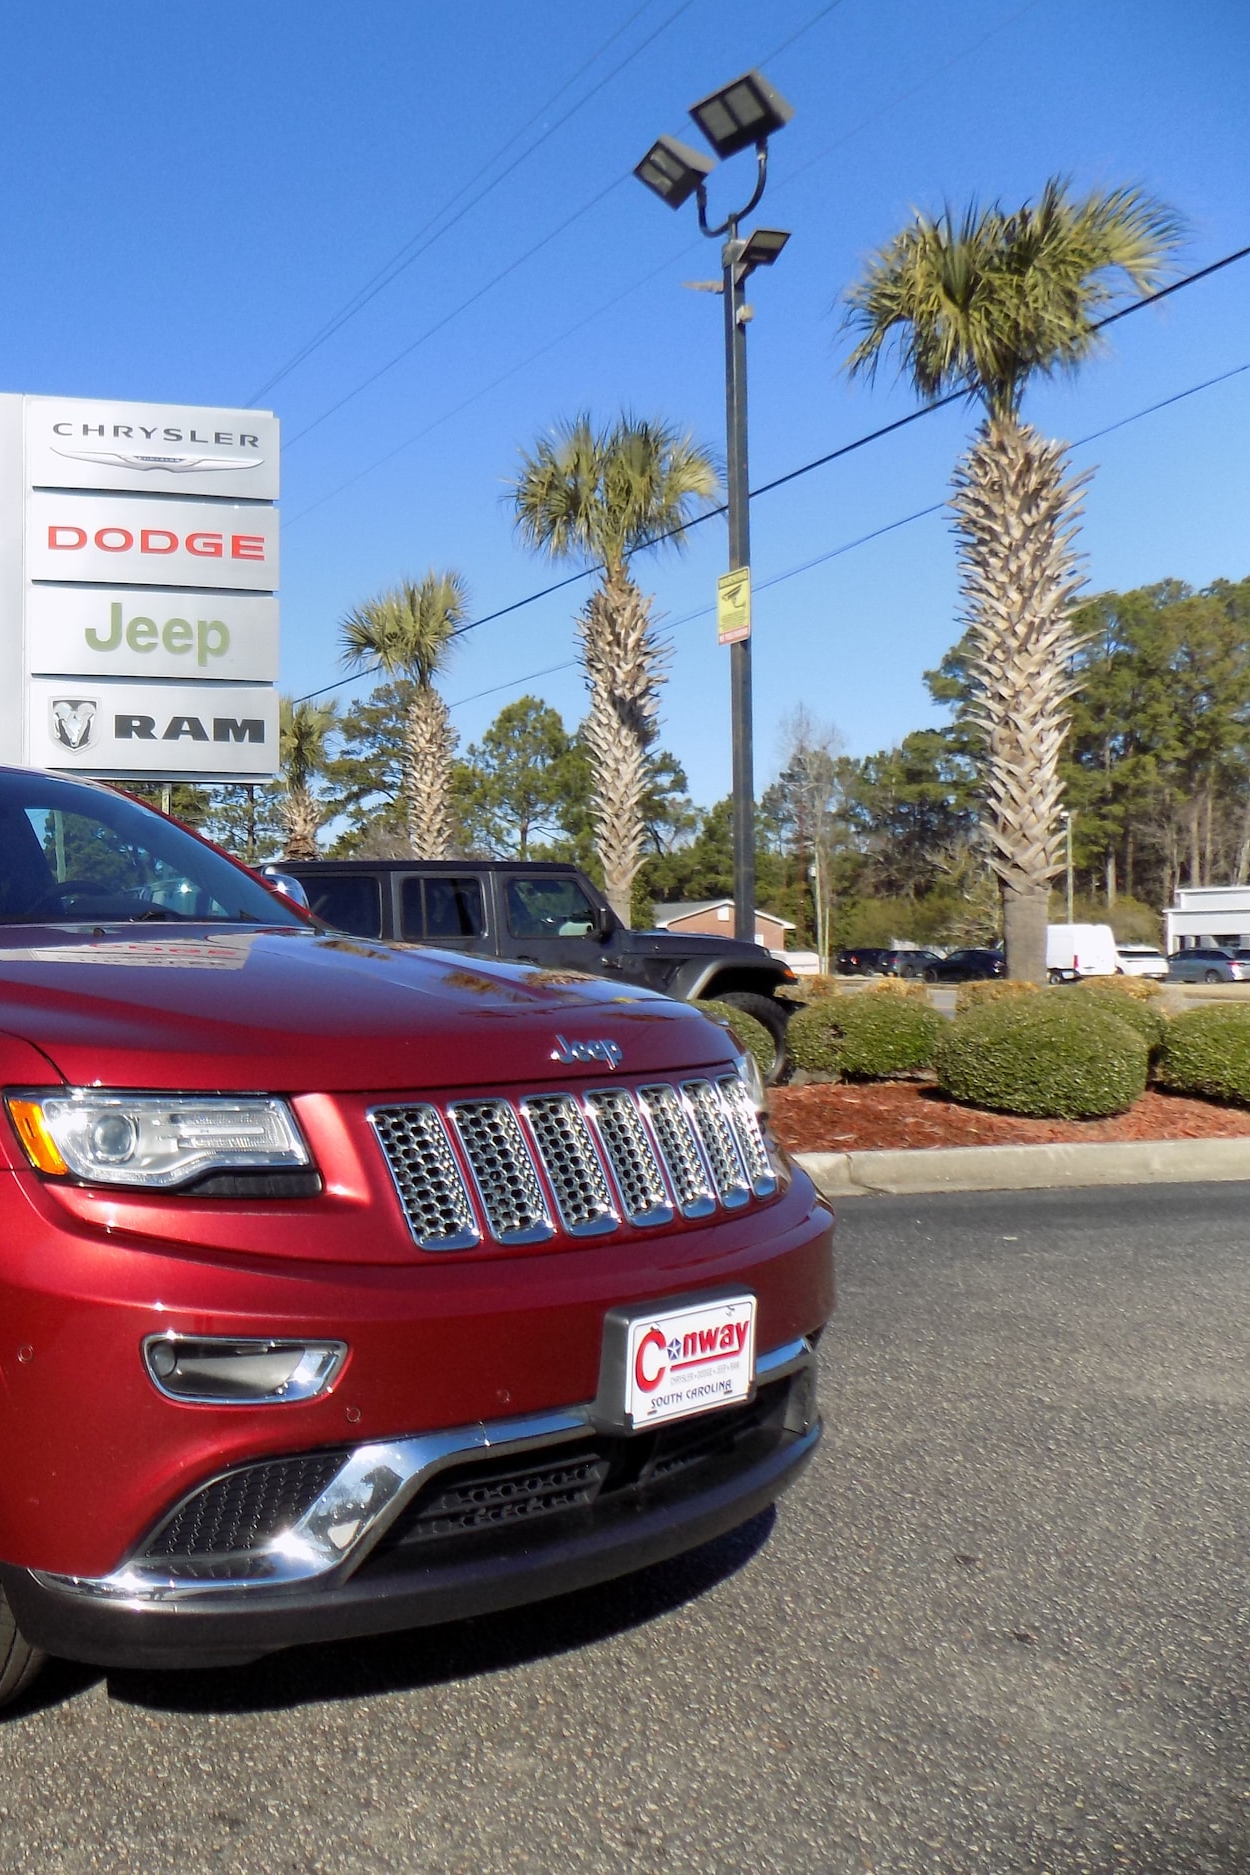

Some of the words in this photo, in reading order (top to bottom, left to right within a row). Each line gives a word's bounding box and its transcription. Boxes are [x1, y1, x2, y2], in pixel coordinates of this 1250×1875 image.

[52, 422, 260, 448] CHRYSLER
[48, 525, 266, 561] DODGE
[84, 601, 231, 667] Jeep
[113, 713, 266, 744] RAM
[550, 1033, 623, 1071] Jeep
[651, 1391, 683, 1409] SOUTH
[686, 1379, 732, 1399] CAROLINA
